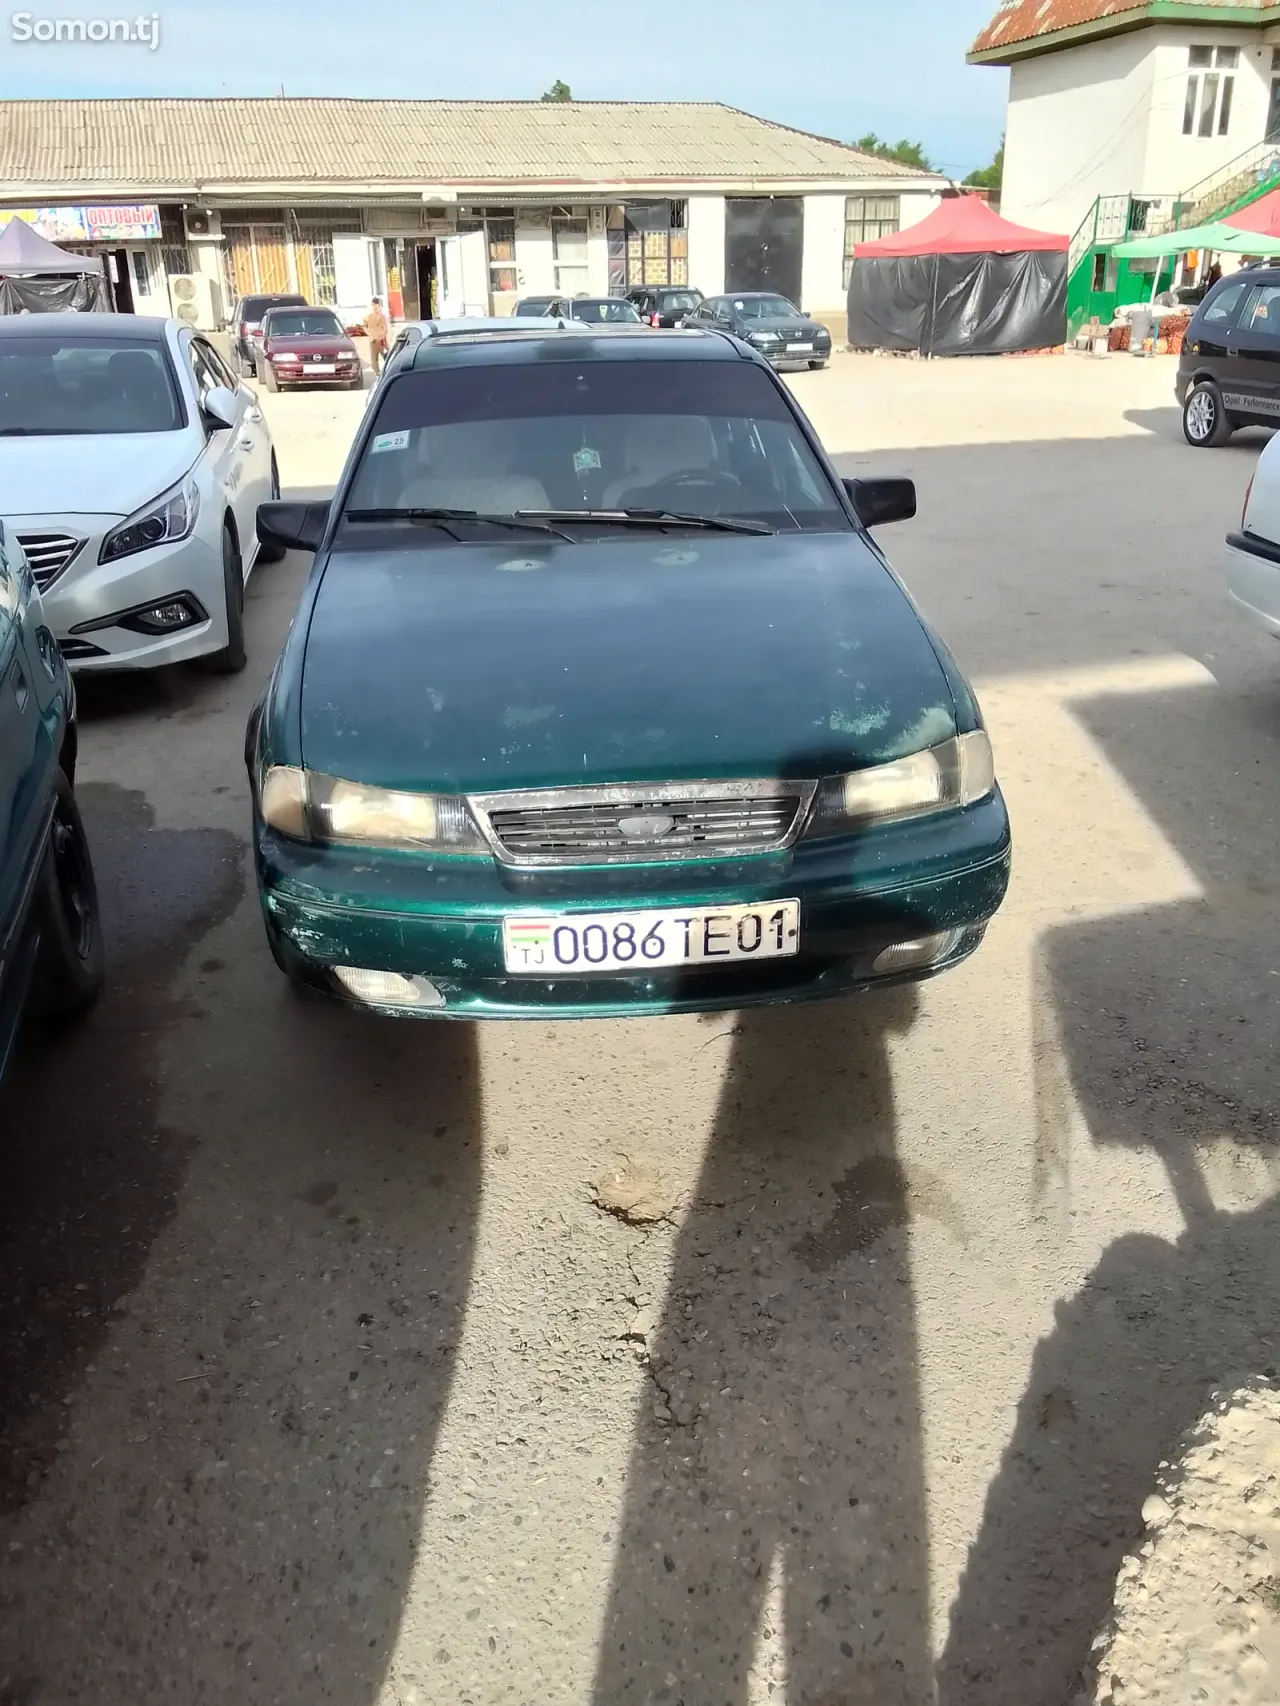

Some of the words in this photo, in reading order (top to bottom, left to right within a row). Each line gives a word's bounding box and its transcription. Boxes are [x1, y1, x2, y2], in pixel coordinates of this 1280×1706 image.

[1224, 394, 1241, 407] Opel
[1243, 396, 1280, 411] Performance
[519, 948, 546, 965] TJ
